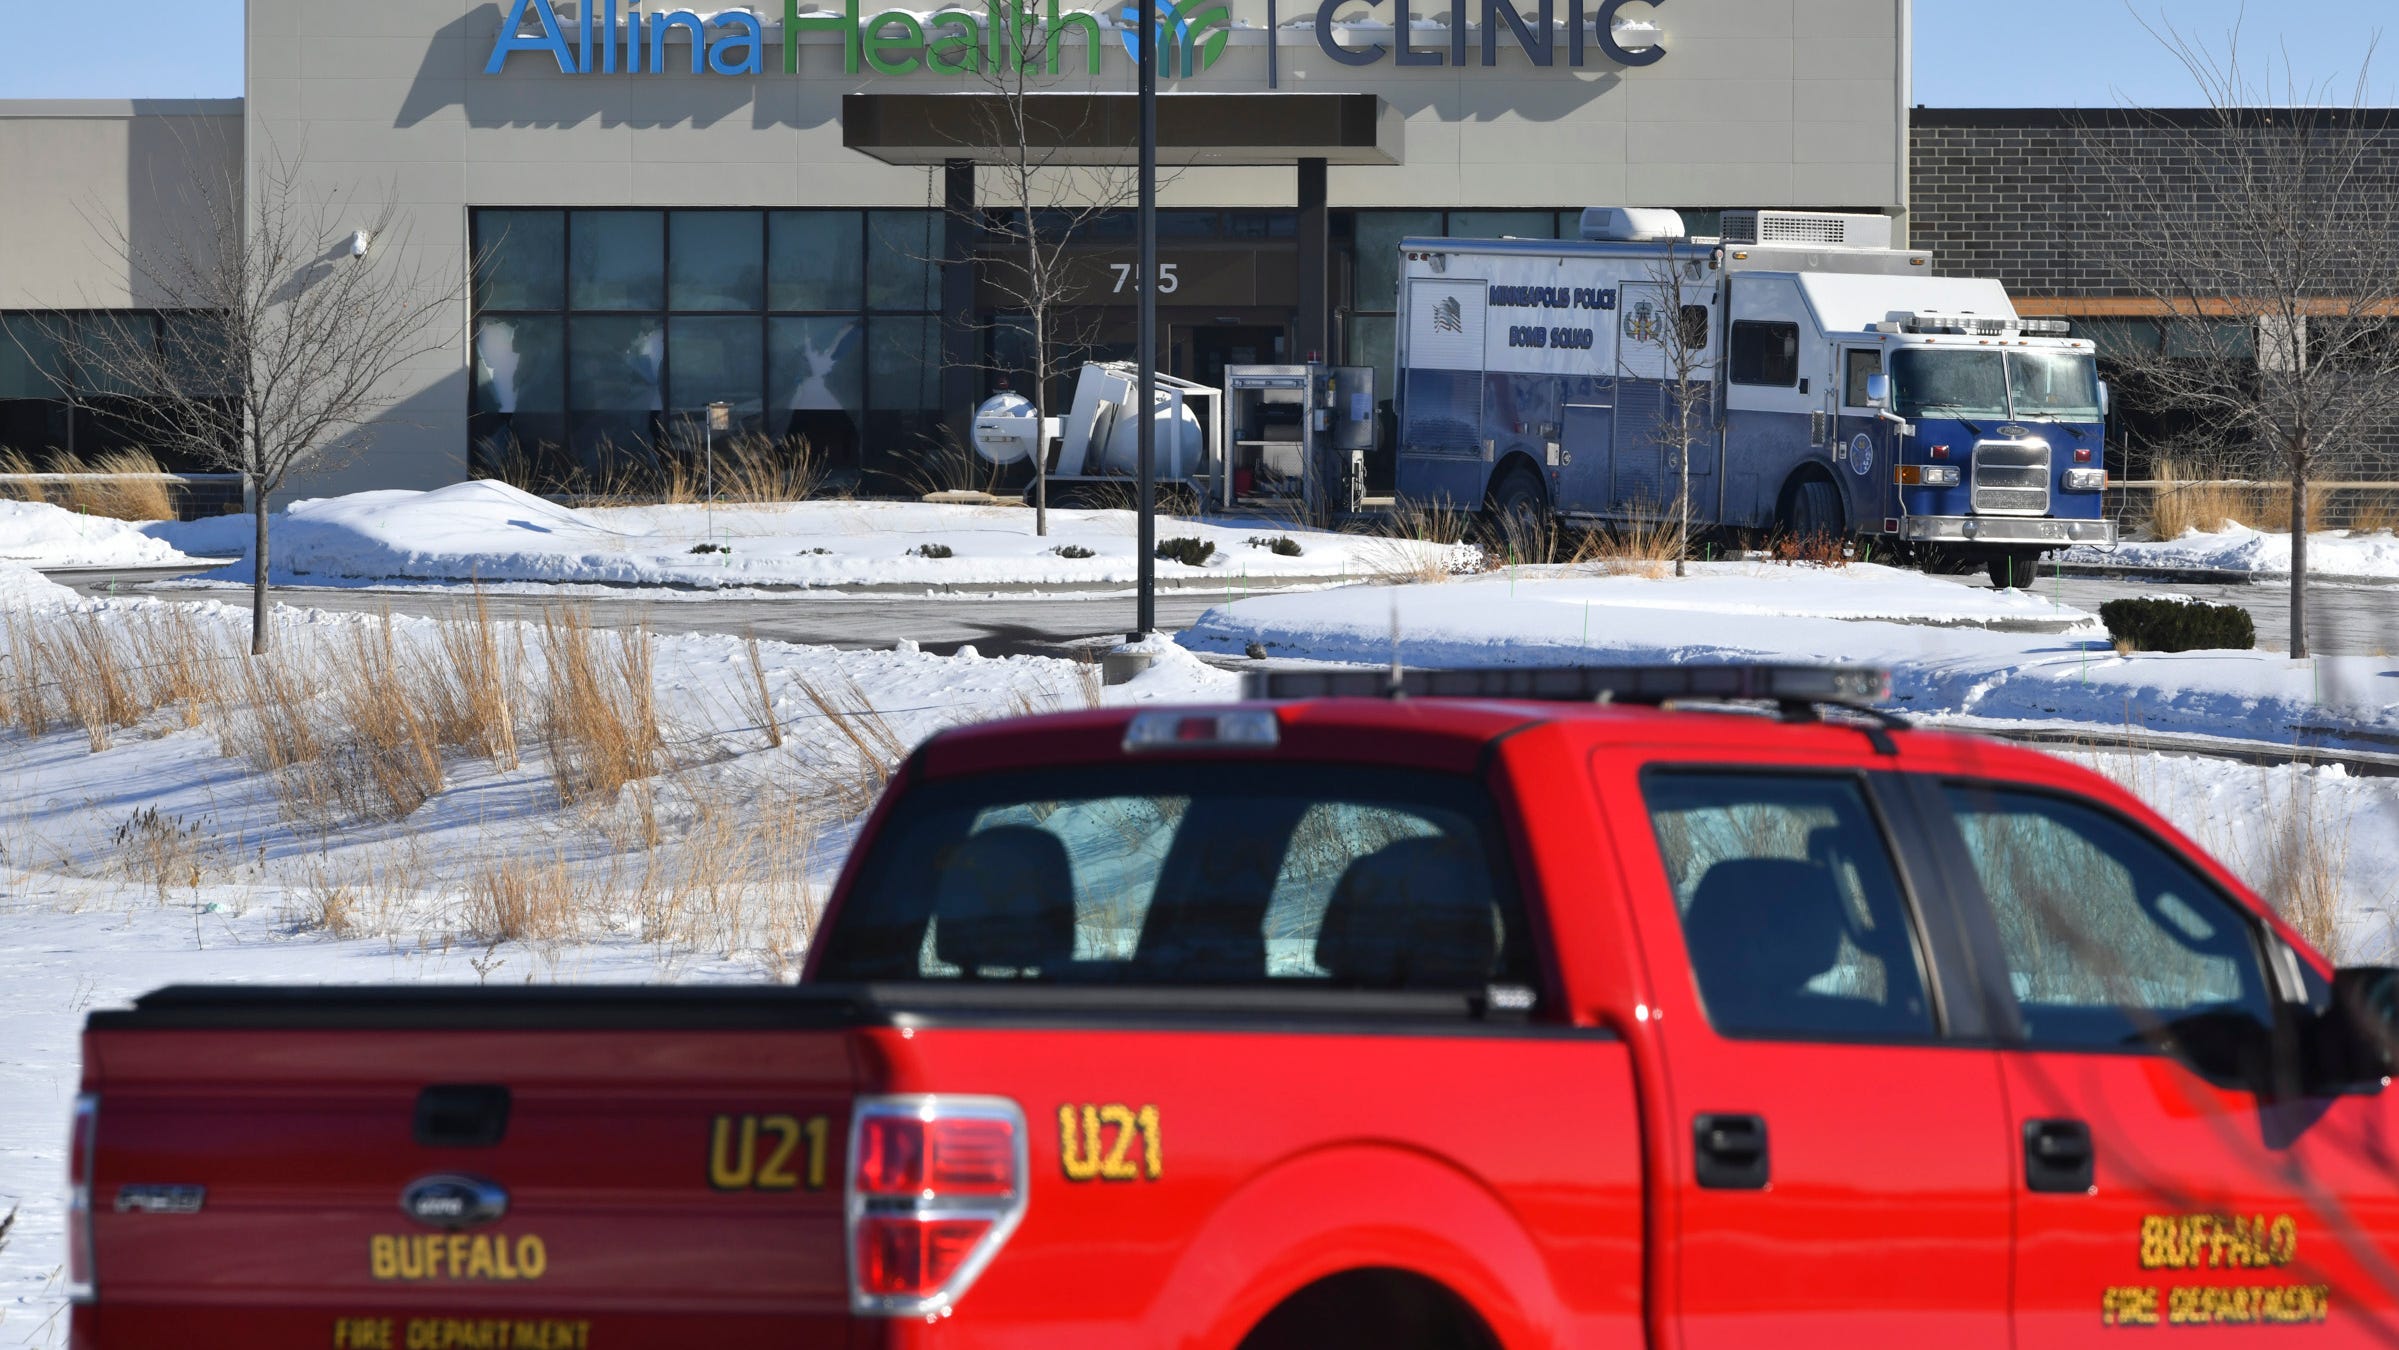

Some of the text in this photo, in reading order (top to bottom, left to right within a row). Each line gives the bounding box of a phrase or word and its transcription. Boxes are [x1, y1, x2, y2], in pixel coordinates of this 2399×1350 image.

[483, 0, 1667, 76] Allina Health CLINIC
[1110, 263, 1178, 293] 75
[1489, 285, 1617, 310] MINNEAPOLIS POLICE
[1509, 326, 1594, 349] BOMB SQUAD
[709, 1114, 828, 1190] U21
[1059, 1103, 1163, 1181] U21
[370, 1233, 547, 1280] BUFFALO
[2140, 1213, 2297, 1269] BUFFALO
[2103, 1284, 2329, 1325] FIRE DEPARTMENT
[334, 1318, 590, 1350] FIRE DEPARTMENT
